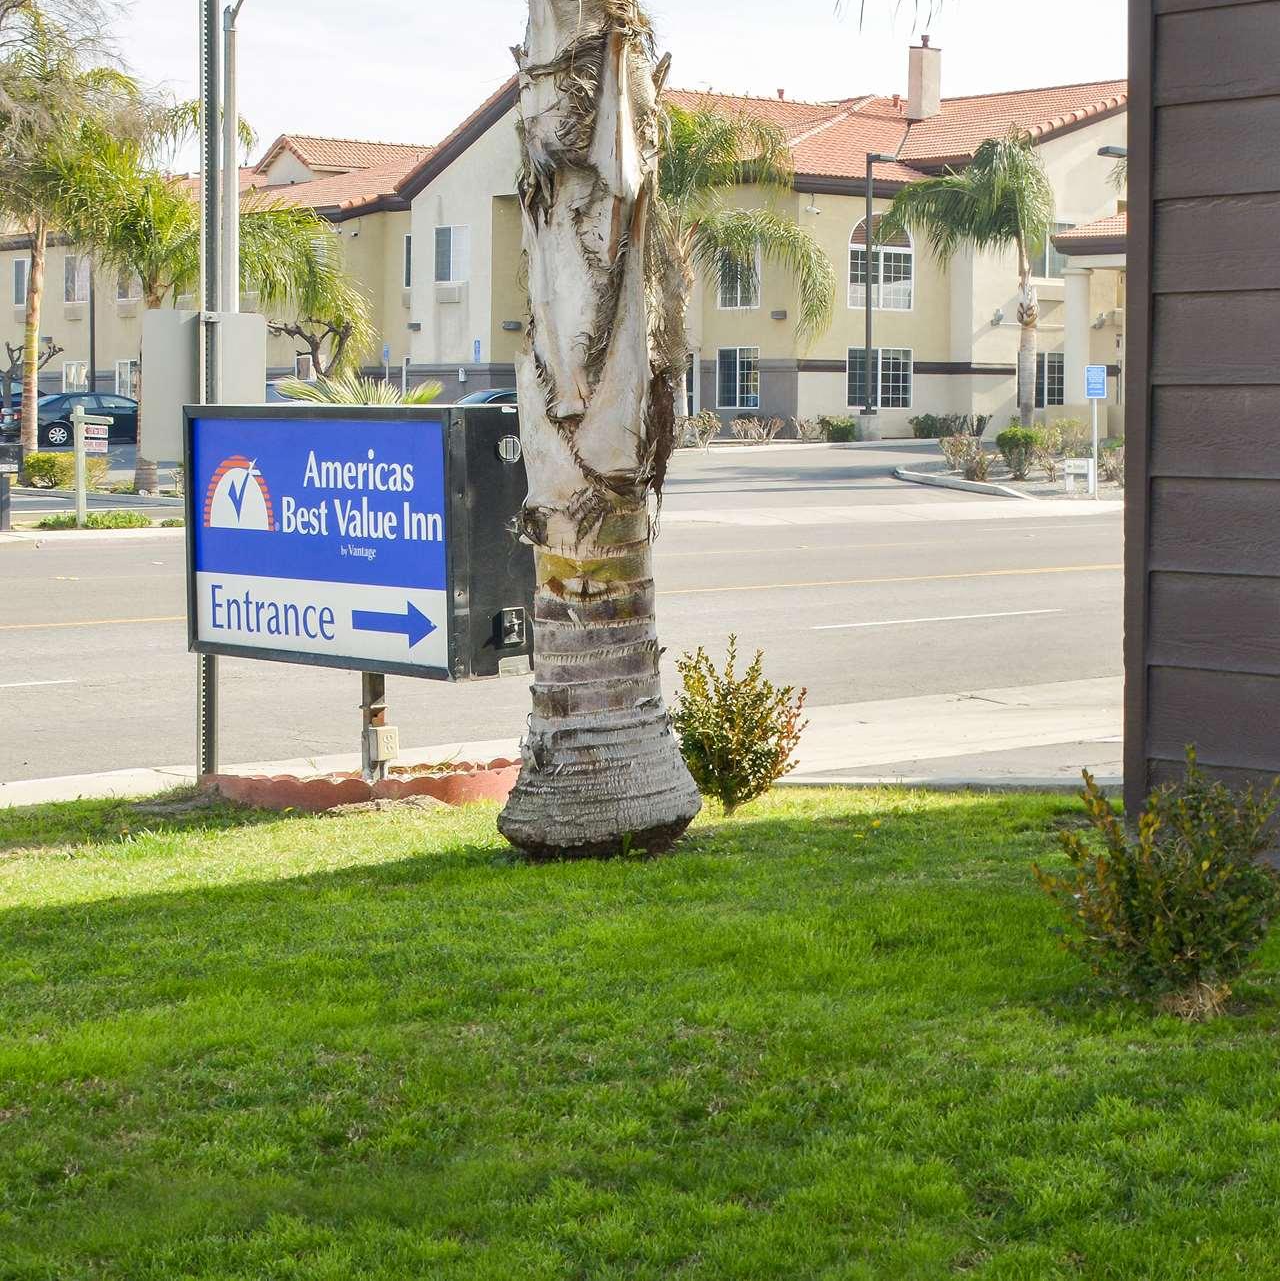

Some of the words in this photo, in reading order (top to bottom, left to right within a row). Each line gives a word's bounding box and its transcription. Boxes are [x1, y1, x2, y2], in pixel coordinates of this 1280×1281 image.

[303, 448, 414, 492] Americas
[281, 496, 329, 536] Best
[333, 496, 398, 540] Value
[403, 501, 443, 542] Inn
[348, 544, 377, 562] Vantage
[210, 583, 336, 641] Entrance
